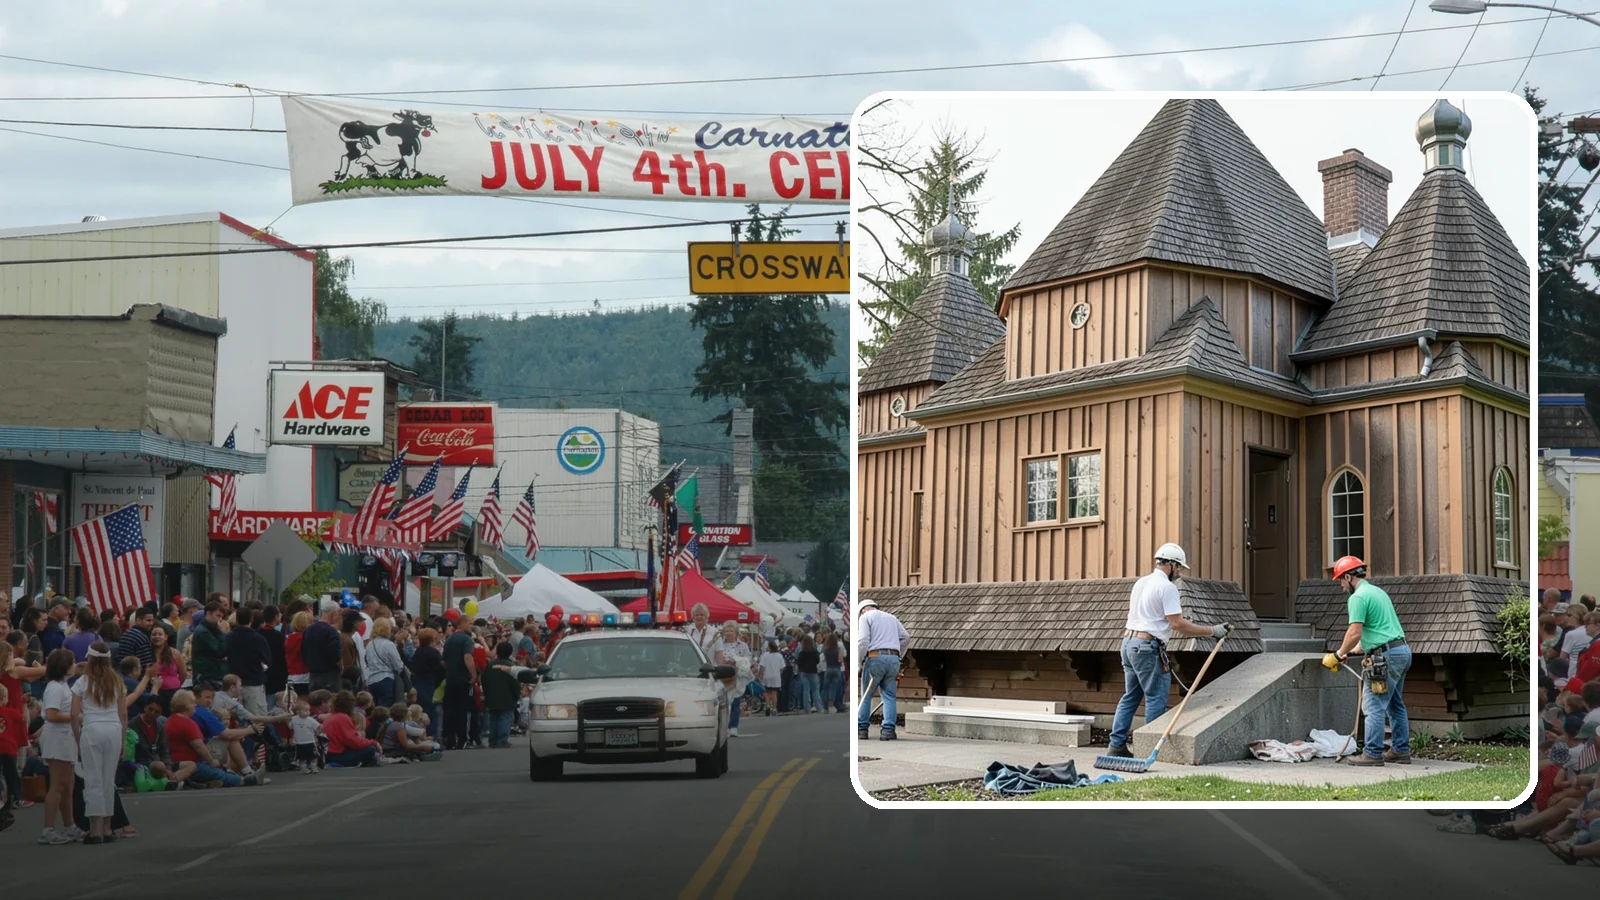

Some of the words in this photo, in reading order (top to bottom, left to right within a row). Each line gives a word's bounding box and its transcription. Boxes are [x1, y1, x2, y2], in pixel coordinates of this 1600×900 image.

[481, 141, 605, 192] JULY
[632, 150, 746, 197] 4th.
[697, 254, 850, 280] CROSSWA
[283, 380, 373, 419] ACE
[406, 409, 452, 421] CEDAR
[284, 421, 370, 436] Hardware
[416, 428, 476, 446] Coca-Cola
[83, 485, 94, 494] St.
[95, 486, 124, 494] Vincent
[126, 486, 136, 494] de
[137, 486, 155, 494] Paul
[688, 526, 741, 534] CRNATION
[699, 535, 730, 543] GLASS
